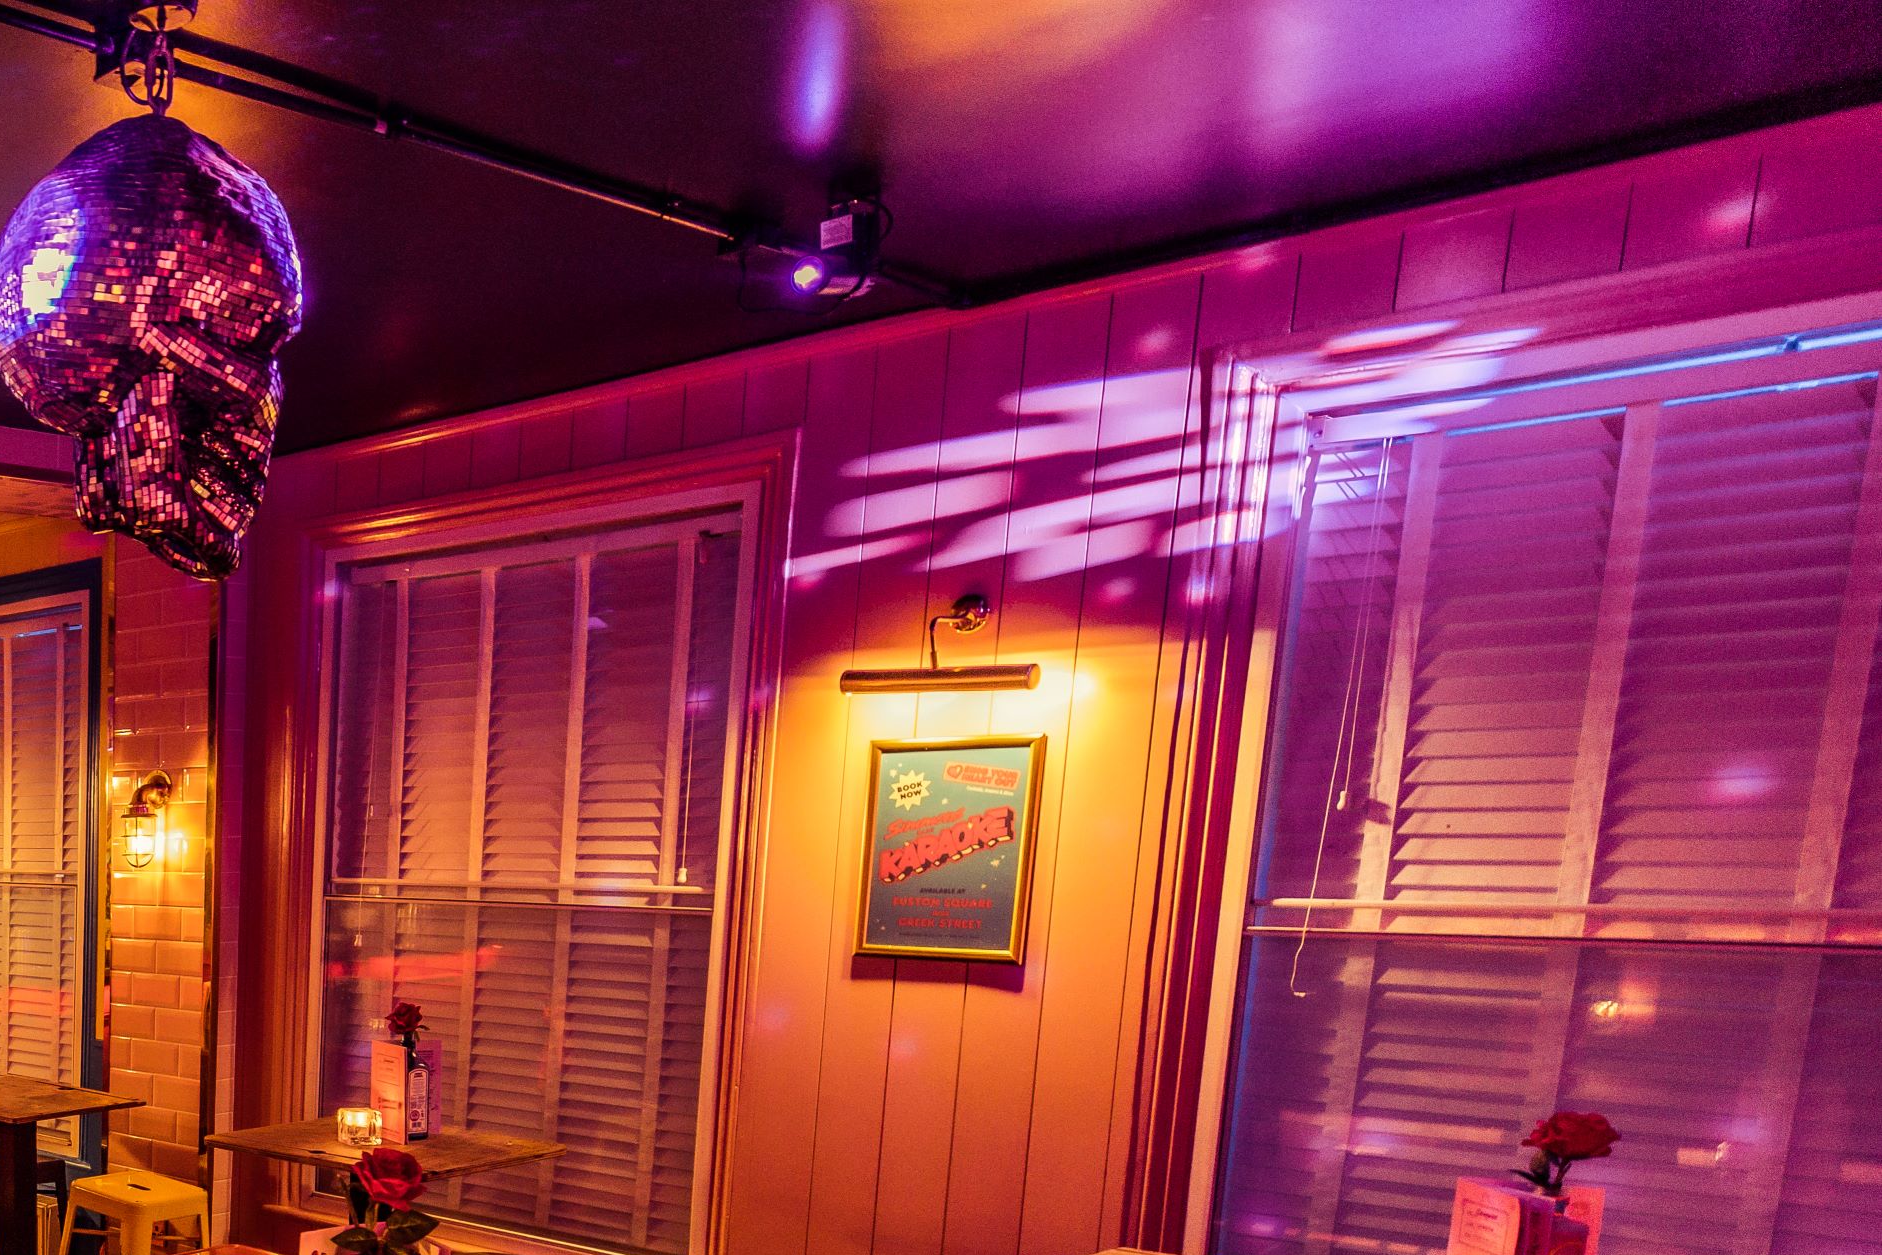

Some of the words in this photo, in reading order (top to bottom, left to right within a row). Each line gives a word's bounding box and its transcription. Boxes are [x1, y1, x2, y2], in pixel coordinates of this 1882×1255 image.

[897, 781, 922, 793] BOOK
[900, 789, 922, 800] NOW
[878, 805, 1014, 883] KARAOKE
[943, 898, 993, 909] SQUARE
[897, 917, 935, 928] GREEK
[938, 918, 983, 930] STREET
